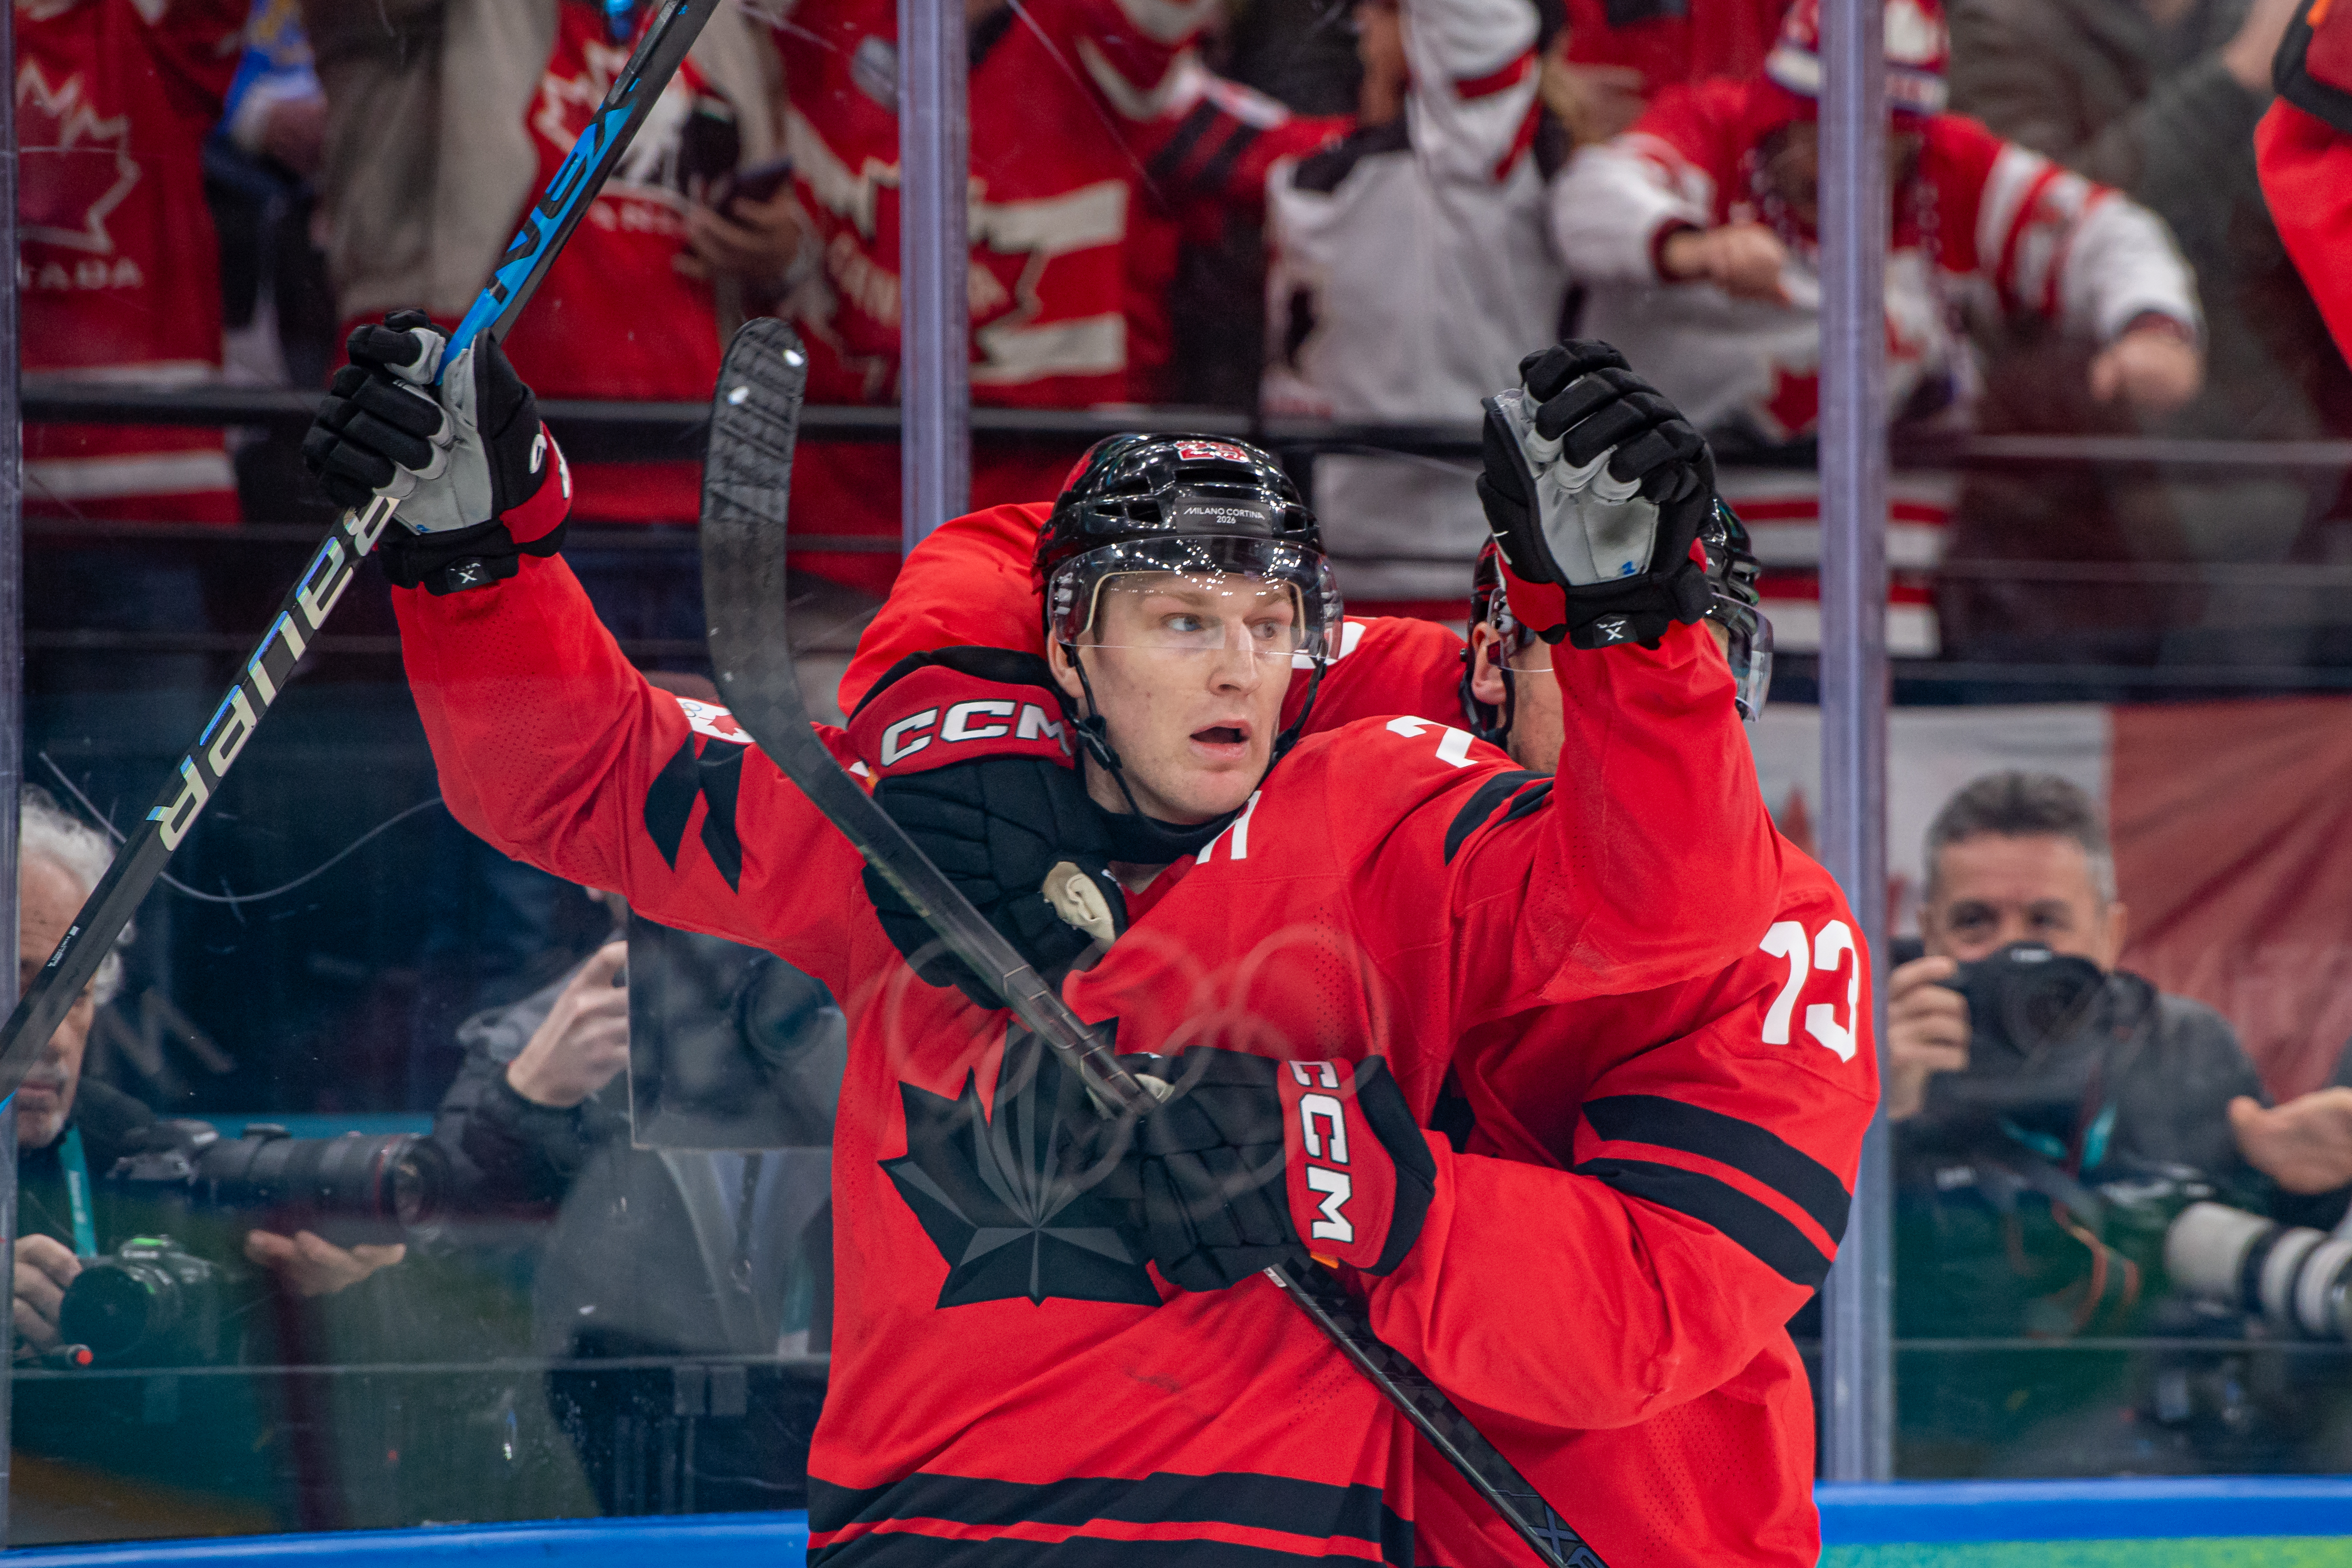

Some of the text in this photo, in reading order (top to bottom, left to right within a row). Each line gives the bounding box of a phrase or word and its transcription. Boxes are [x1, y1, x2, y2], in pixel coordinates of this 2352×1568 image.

[1183, 506, 1266, 520] MILANO CORTINA
[1216, 515, 1236, 524] 2026
[881, 699, 1072, 768] CCM
[1287, 1060, 1355, 1245] CCM
